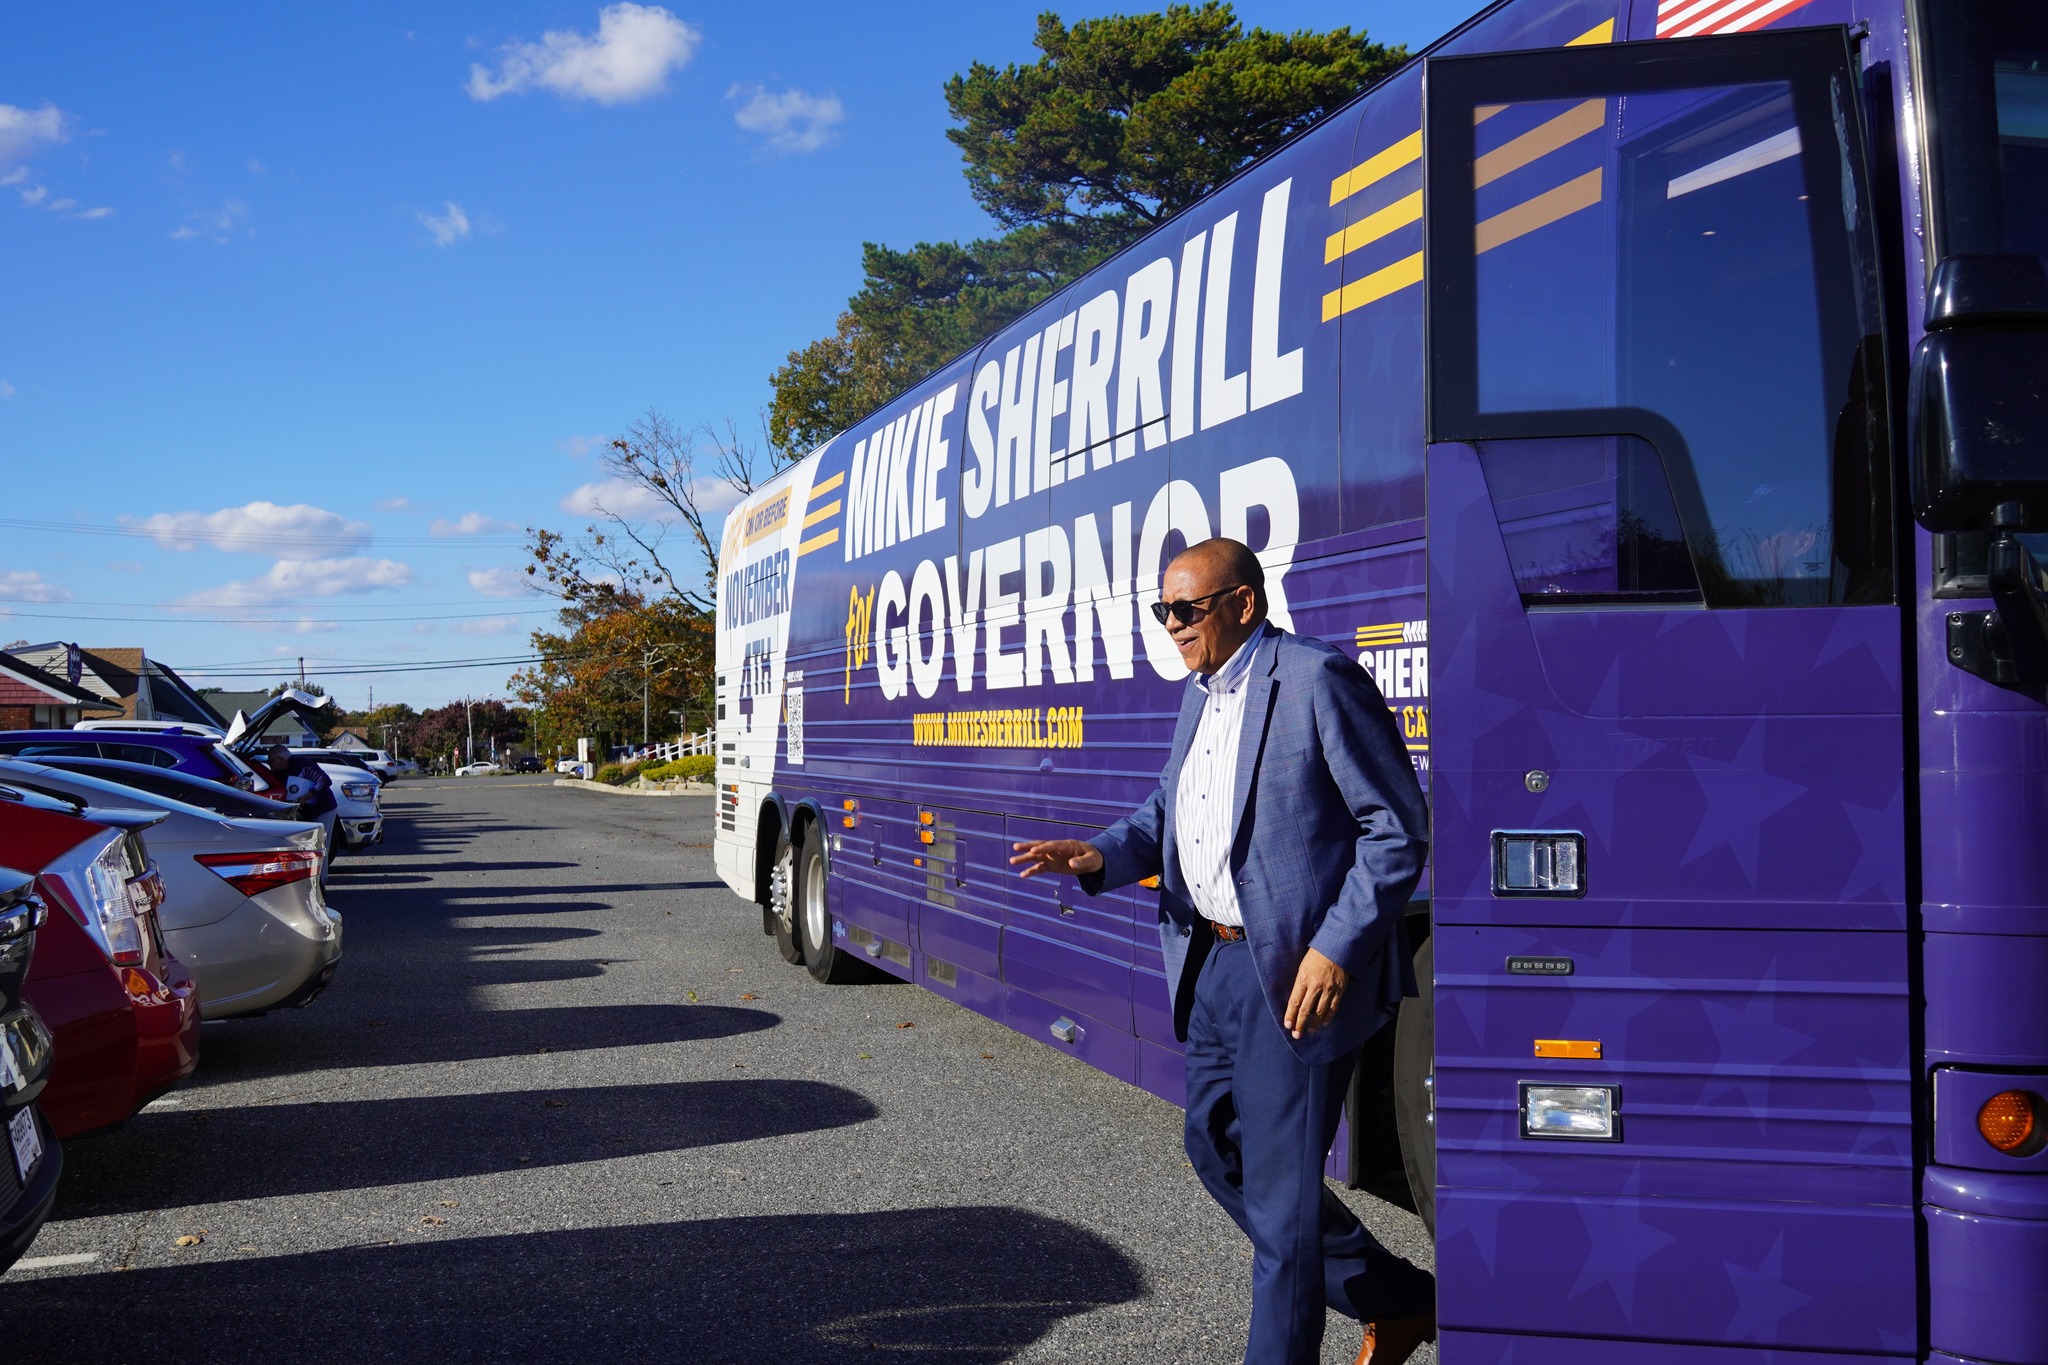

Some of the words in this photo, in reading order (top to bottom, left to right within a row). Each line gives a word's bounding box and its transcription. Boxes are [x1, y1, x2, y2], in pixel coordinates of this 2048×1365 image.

[845, 382, 958, 562] MIKIE
[963, 177, 1304, 519] SHERRILL
[763, 496, 788, 527] BEFORE
[725, 547, 790, 631] NOVEMBER
[845, 583, 876, 705] for
[875, 456, 1300, 701] GOVERNOR
[738, 636, 772, 733] 4TH
[1402, 705, 1428, 738] CA
[913, 706, 1083, 749] WWW.MIKIESHERRILL.COM
